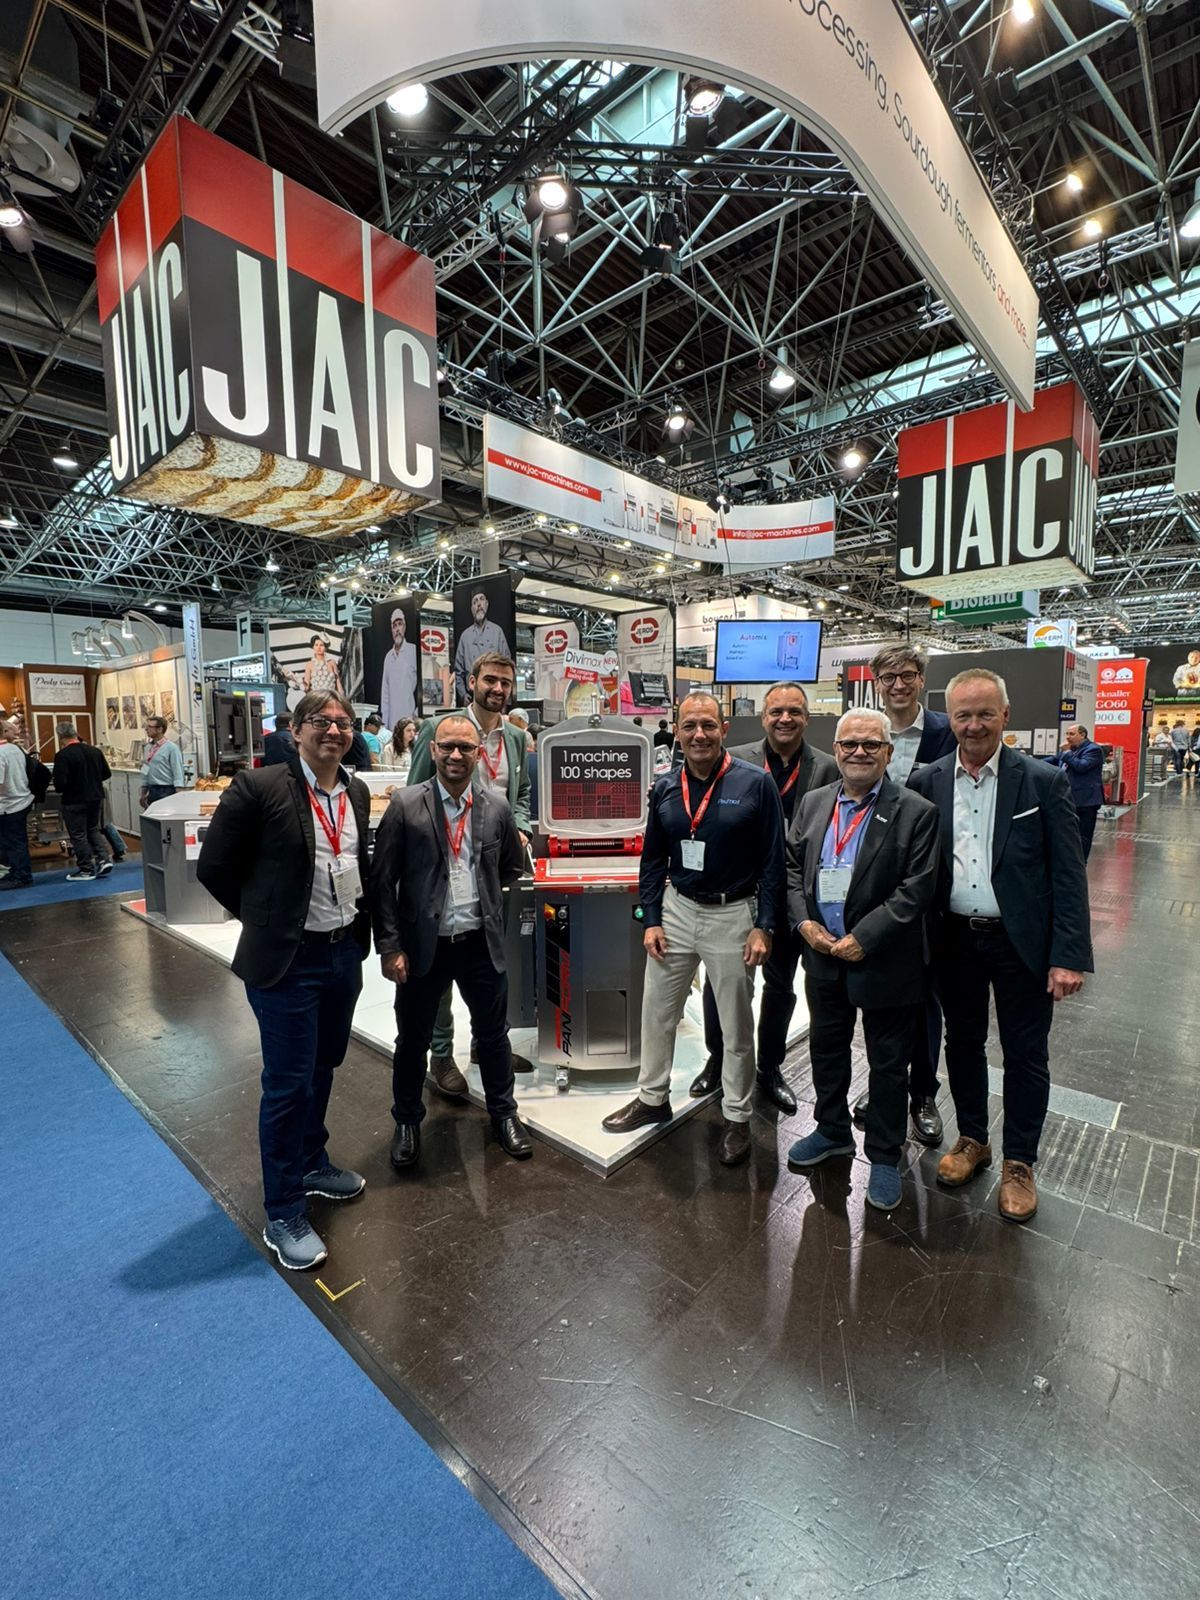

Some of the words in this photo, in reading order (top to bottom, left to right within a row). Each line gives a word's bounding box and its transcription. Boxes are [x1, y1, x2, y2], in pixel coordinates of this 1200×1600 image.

[893, 92, 953, 217] Sourdough
[997, 283, 1012, 316] and
[110, 241, 189, 482] JAC
[201, 249, 434, 489] JAC
[504, 457, 589, 495] www.jac-machines.com
[899, 447, 1064, 577] JAC
[1068, 450, 1098, 576] JAC
[240, 617, 248, 647] F
[334, 589, 348, 625] E
[560, 766, 581, 779] 100
[584, 766, 632, 781] shapes
[563, 750, 568, 763] 1
[571, 749, 629, 763] machine
